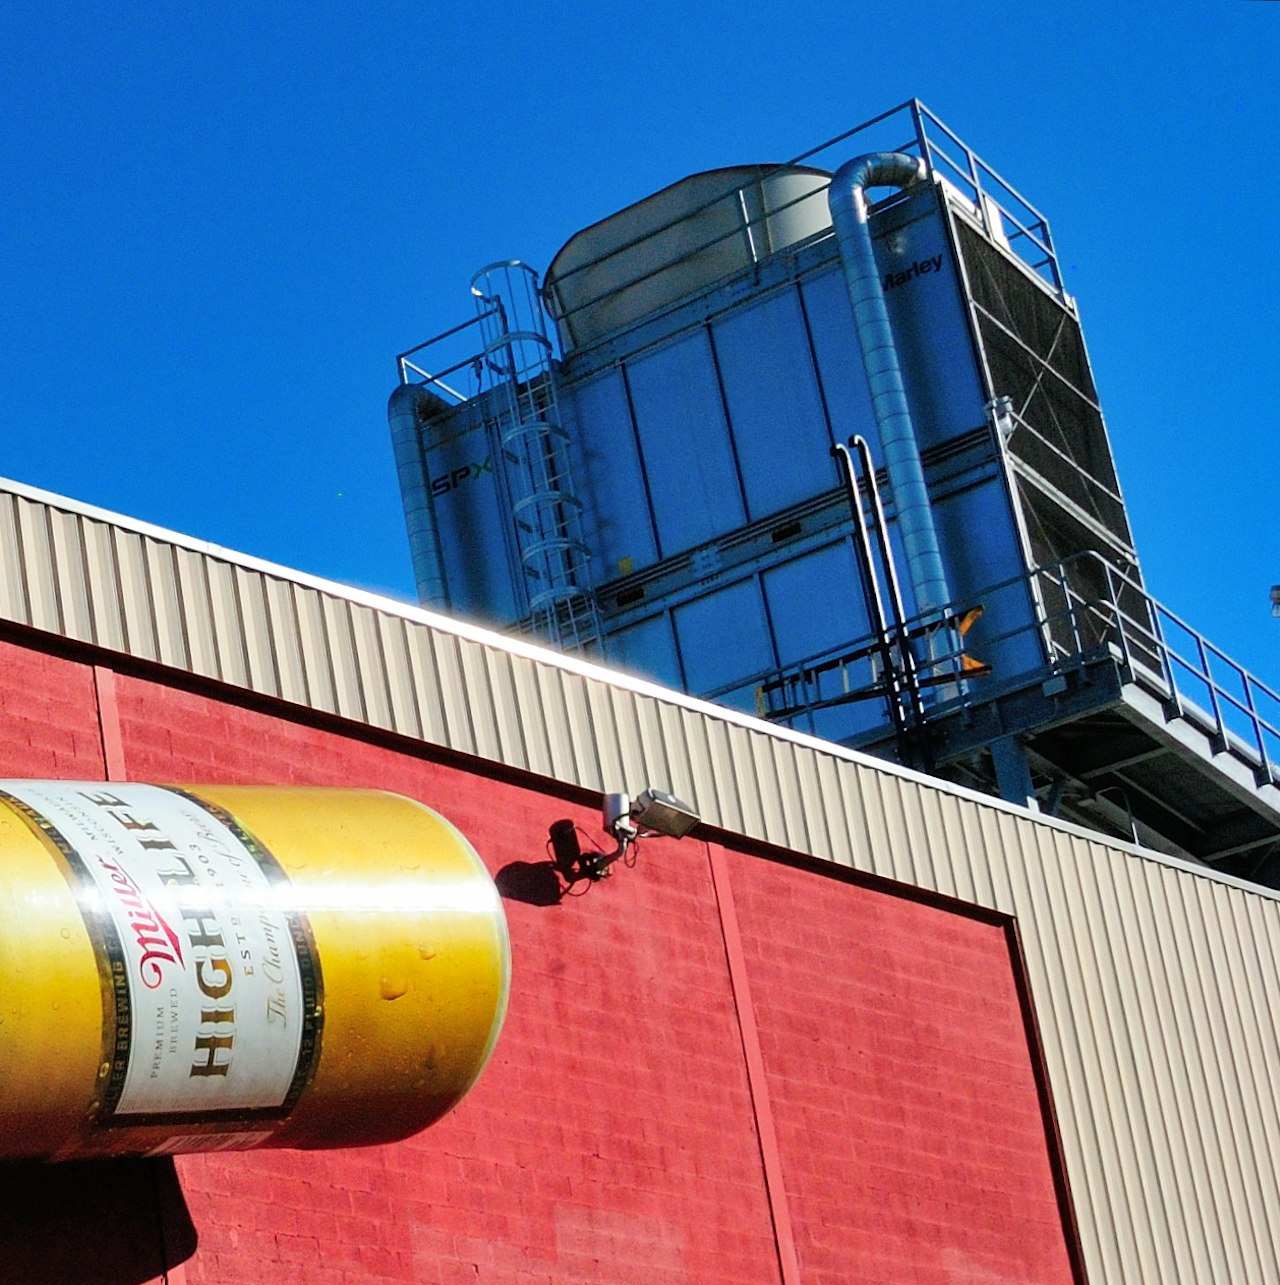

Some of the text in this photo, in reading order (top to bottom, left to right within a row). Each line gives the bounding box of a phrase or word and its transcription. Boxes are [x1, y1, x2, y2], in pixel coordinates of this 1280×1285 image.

[431, 456, 494, 498] SPX
[76, 791, 200, 887] LIFE
[188, 844, 225, 887] 1903
[95, 853, 186, 990] Miller
[112, 960, 130, 1051] BREWING
[168, 987, 180, 1055] BREWED
[178, 905, 236, 1080] HIGH
[266, 989, 287, 1029] The
[150, 1006, 165, 1080] PREMIUM
